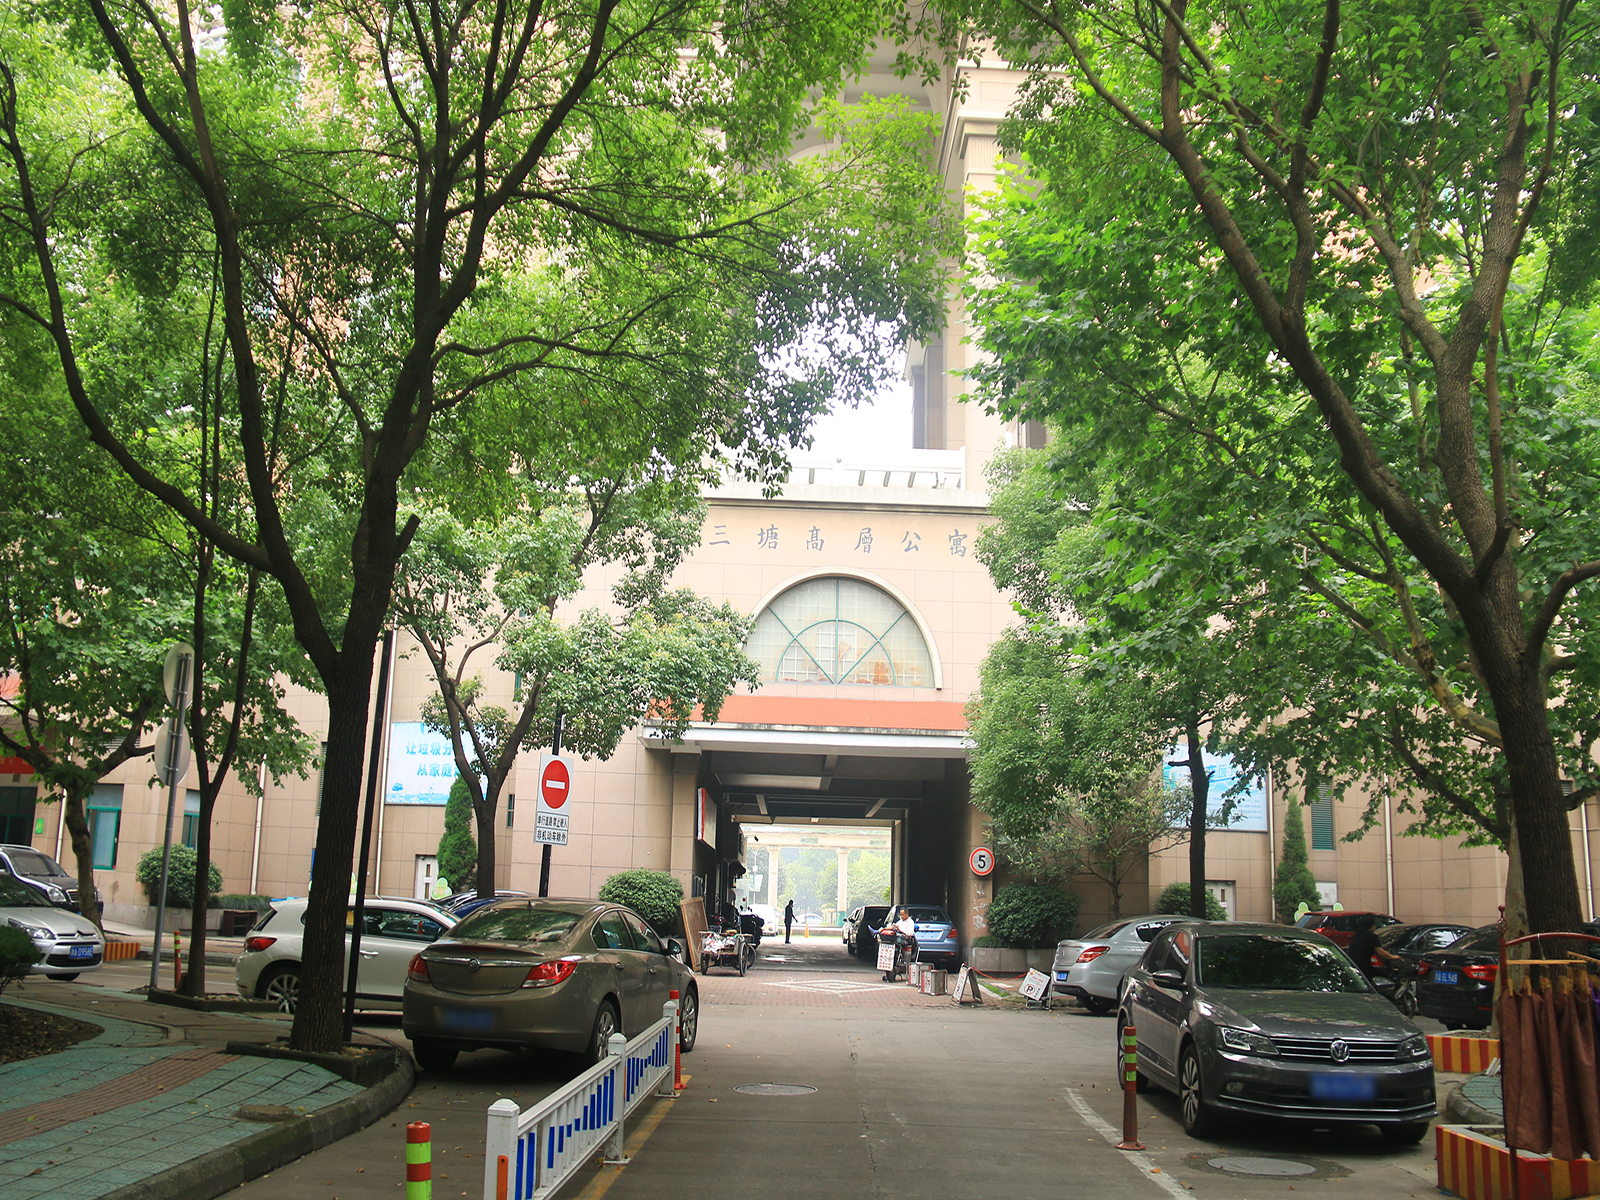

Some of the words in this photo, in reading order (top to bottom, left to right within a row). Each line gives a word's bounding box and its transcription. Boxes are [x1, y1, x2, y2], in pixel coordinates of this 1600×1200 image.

[406, 742, 464, 755] 让垃圾分
[537, 830, 566, 842] 非机动车除外
[977, 854, 986, 869] 5
